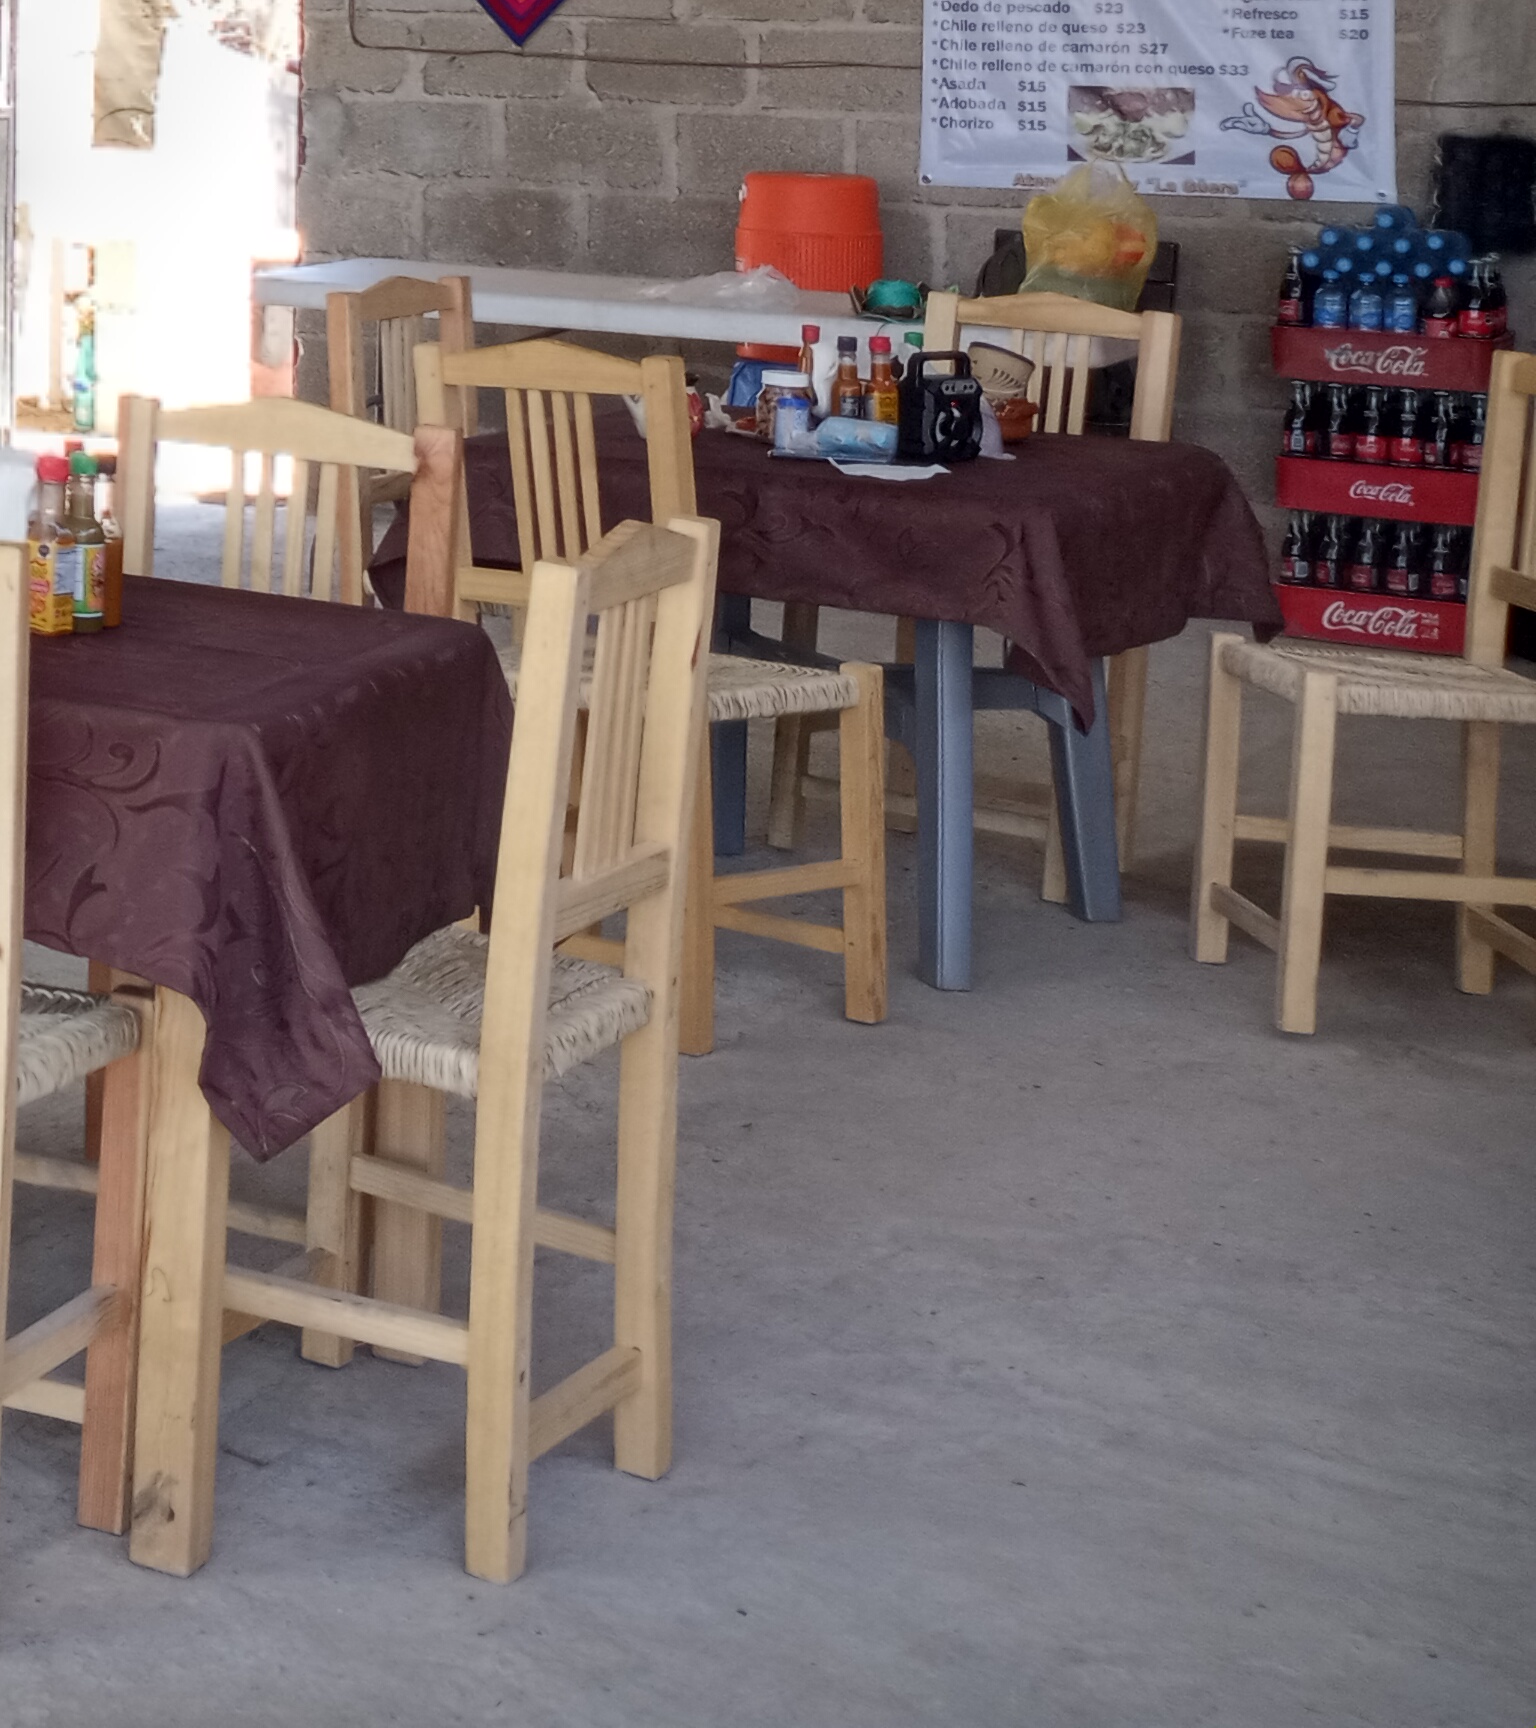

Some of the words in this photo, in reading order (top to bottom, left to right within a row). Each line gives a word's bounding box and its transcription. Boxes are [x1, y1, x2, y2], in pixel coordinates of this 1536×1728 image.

[984, 1, 1002, 13] de
[1007, 1, 1071, 15] pescado
[1094, 3, 1123, 14] $23
[1018, 80, 1046, 93] $15
[1017, 100, 1047, 112] $15
[1018, 120, 1047, 131] $15
[1322, 601, 1420, 639] Coca-Cola
